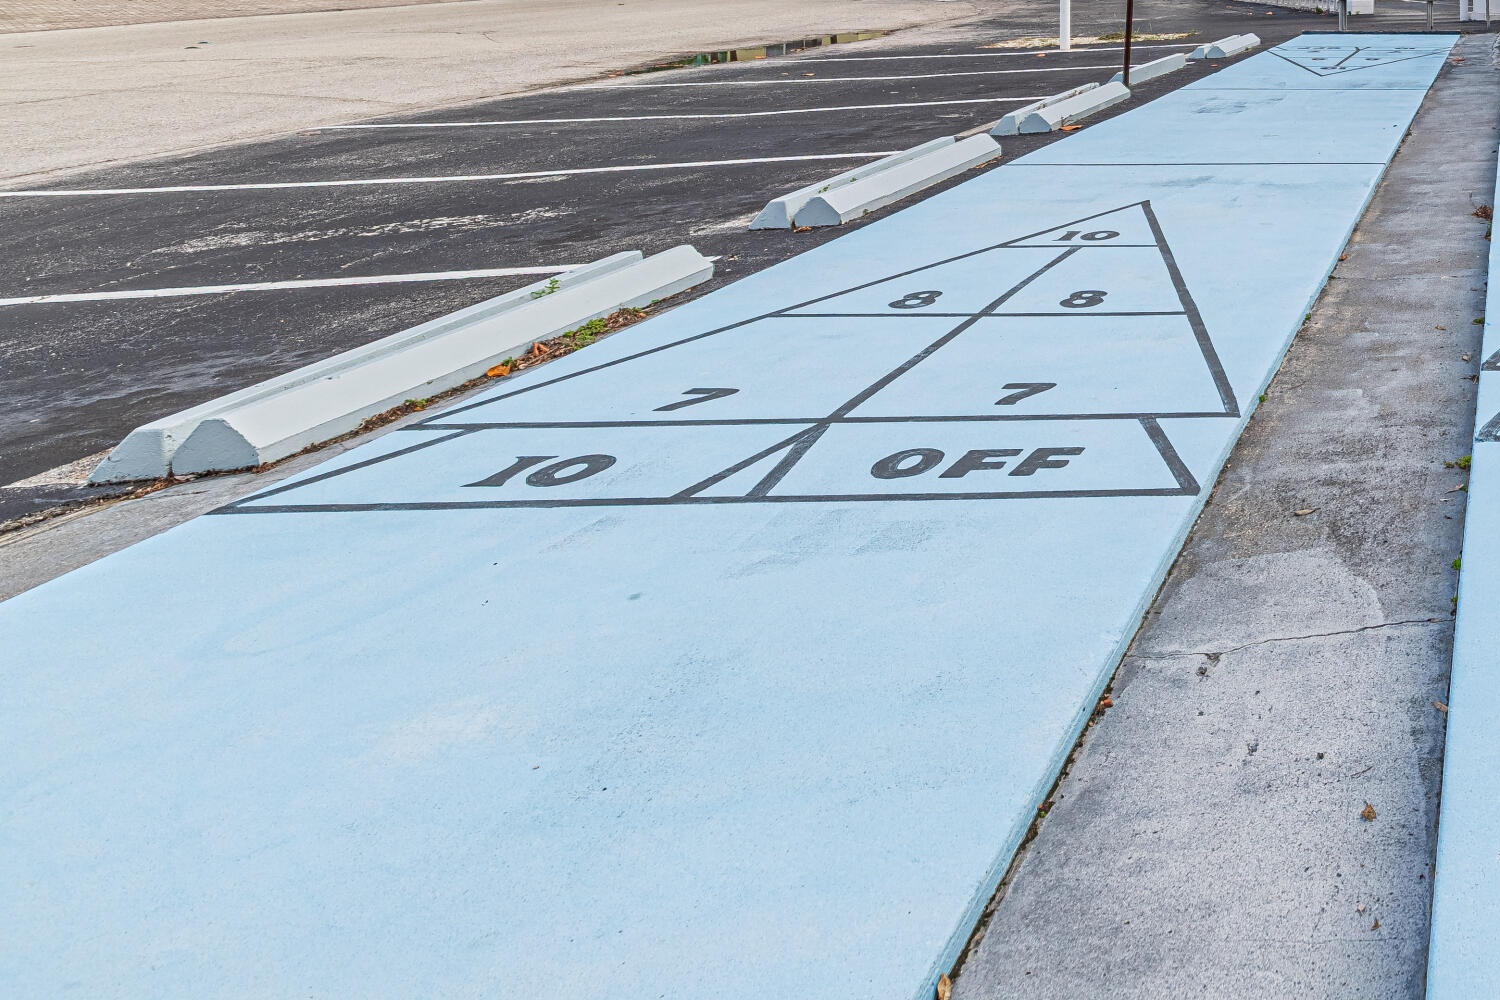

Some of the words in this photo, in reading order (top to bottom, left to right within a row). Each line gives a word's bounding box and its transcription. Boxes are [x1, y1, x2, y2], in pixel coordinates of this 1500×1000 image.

[1053, 229, 1121, 243] 10
[889, 290, 943, 310] 8
[1060, 290, 1109, 310] 8
[653, 387, 740, 412] 7
[994, 382, 1058, 407] 7
[461, 454, 618, 489] 10
[869, 446, 1086, 481] OFF
